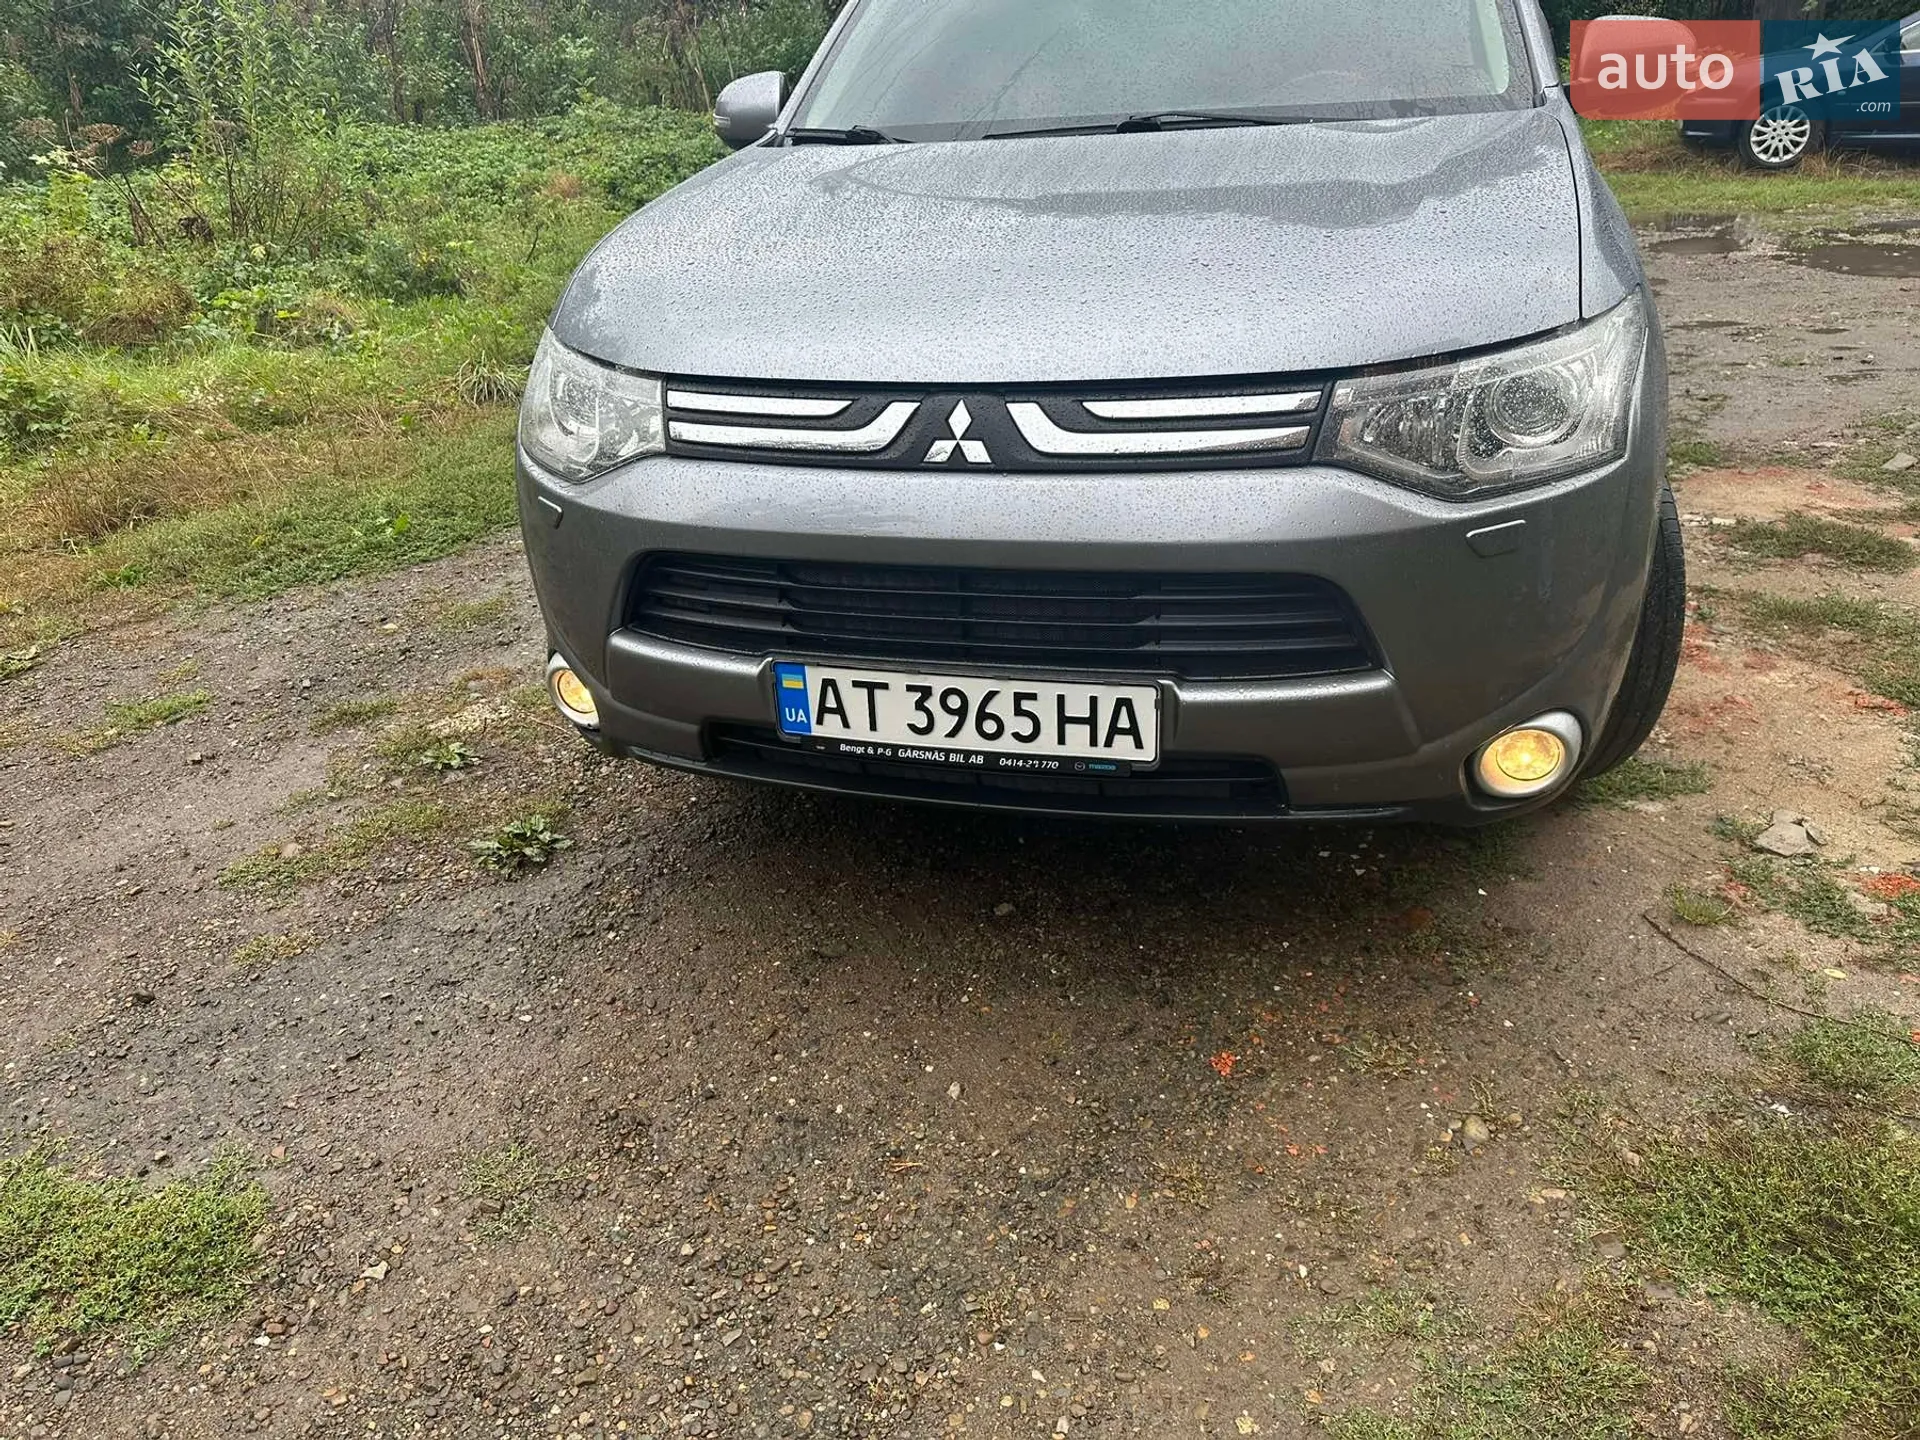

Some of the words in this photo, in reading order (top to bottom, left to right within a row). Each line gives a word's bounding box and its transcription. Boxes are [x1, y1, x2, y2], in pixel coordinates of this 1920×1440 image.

[785, 707, 808, 724] UA
[815, 678, 889, 732] AT
[905, 684, 1041, 743] 3965
[1056, 693, 1144, 749] HA
[839, 743, 865, 754] Bengt
[867, 746, 874, 755] &
[949, 753, 966, 763] BIL
[968, 754, 984, 764] AB
